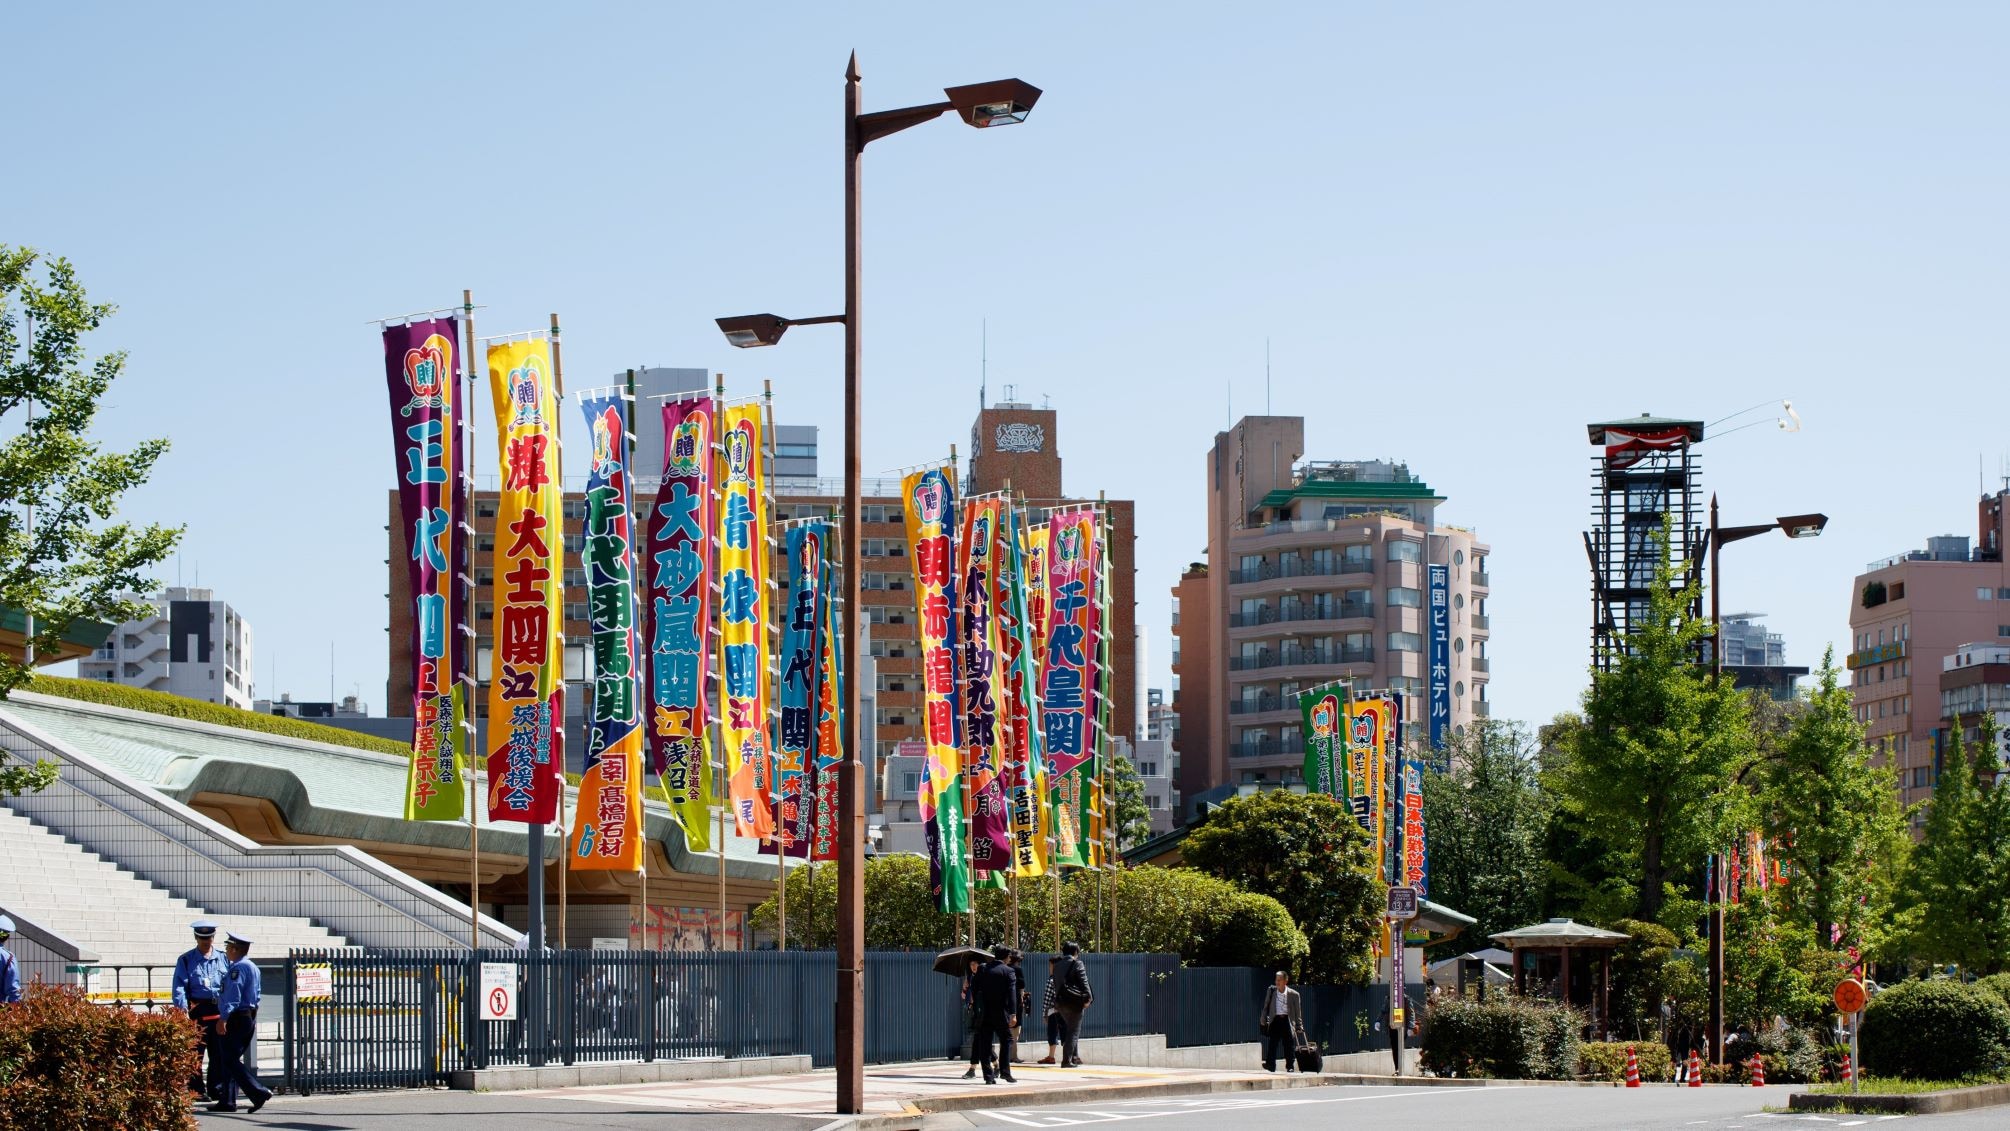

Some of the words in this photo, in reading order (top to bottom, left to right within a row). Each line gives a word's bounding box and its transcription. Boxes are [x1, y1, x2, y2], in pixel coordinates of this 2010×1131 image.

[517, 381, 534, 404] 贈
[675, 435, 694, 457] 贈
[1431, 568, 1447, 717] 両国ビューホテル
[414, 698, 438, 808] 中澤京子
[439, 696, 453, 783] 医療法人誠翔会
[504, 705, 537, 810] 茨城後援会
[740, 739, 755, 824] 寺尾
[662, 742, 689, 828] 浅沼一
[1406, 794, 1426, 881] 日本相撲協会
